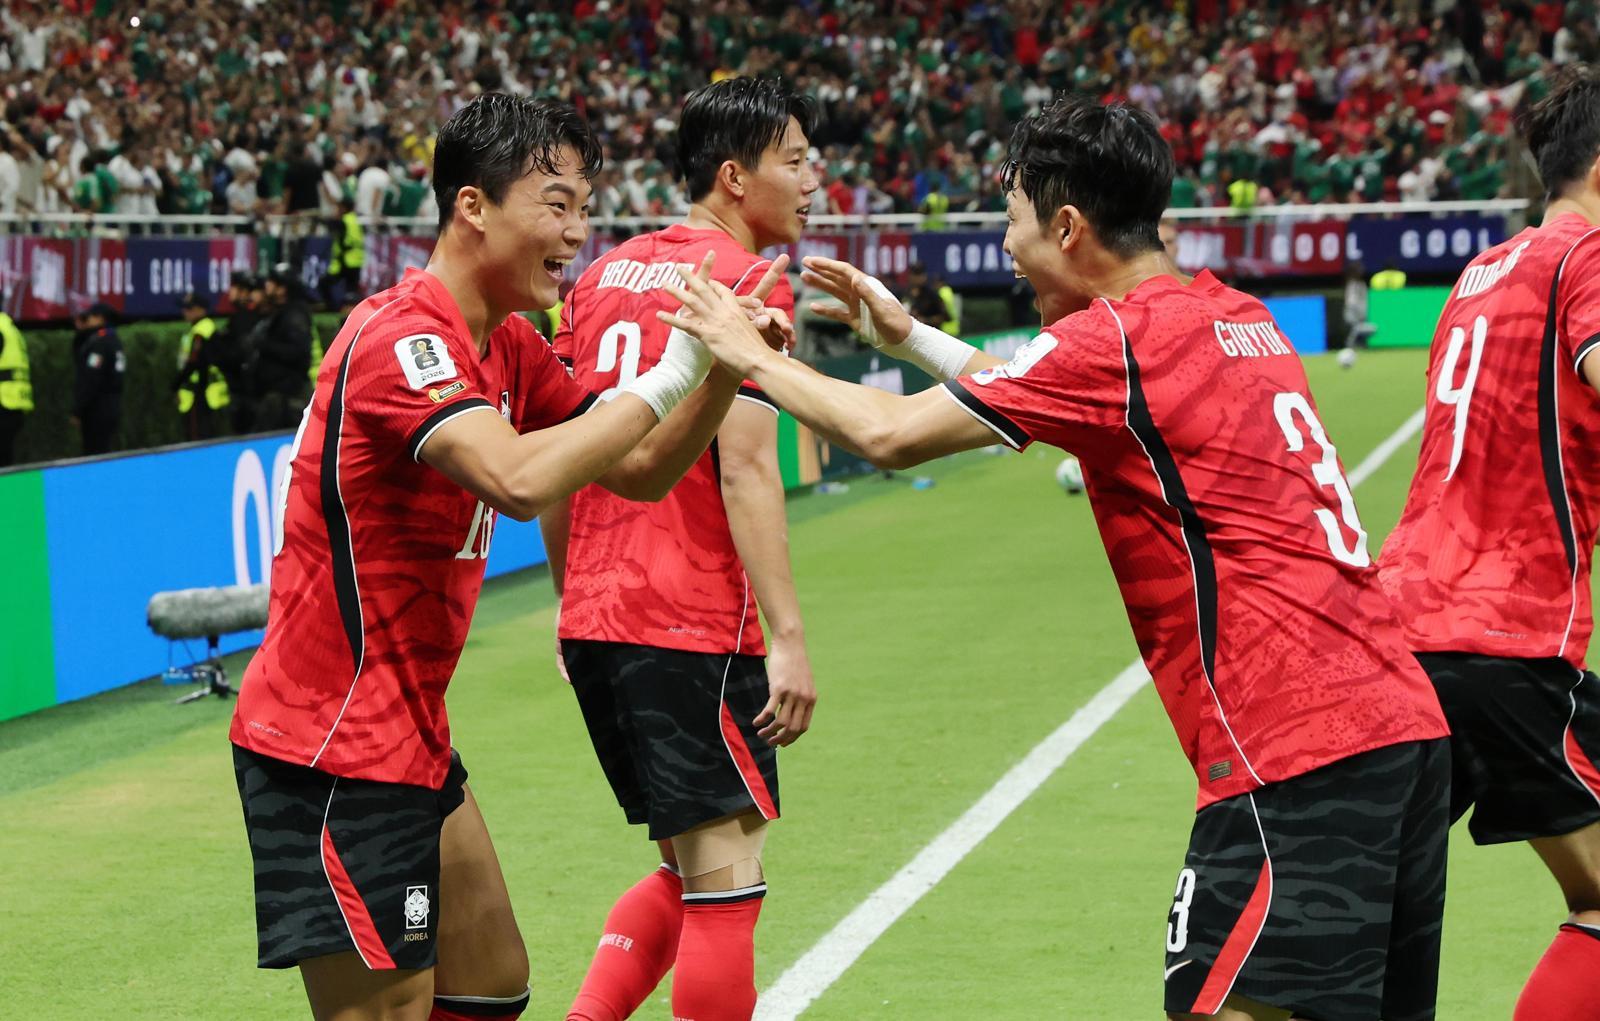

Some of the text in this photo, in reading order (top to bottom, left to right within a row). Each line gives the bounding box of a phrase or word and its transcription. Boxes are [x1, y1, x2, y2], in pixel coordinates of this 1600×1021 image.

[150, 257, 195, 295] GOAL
[1213, 320, 1291, 357] GIHYUK
[1436, 315, 1487, 482] 4
[1273, 392, 1370, 568] 3
[455, 499, 494, 560] 18
[404, 932, 429, 942] KOREA
[1166, 868, 1196, 953] 3
